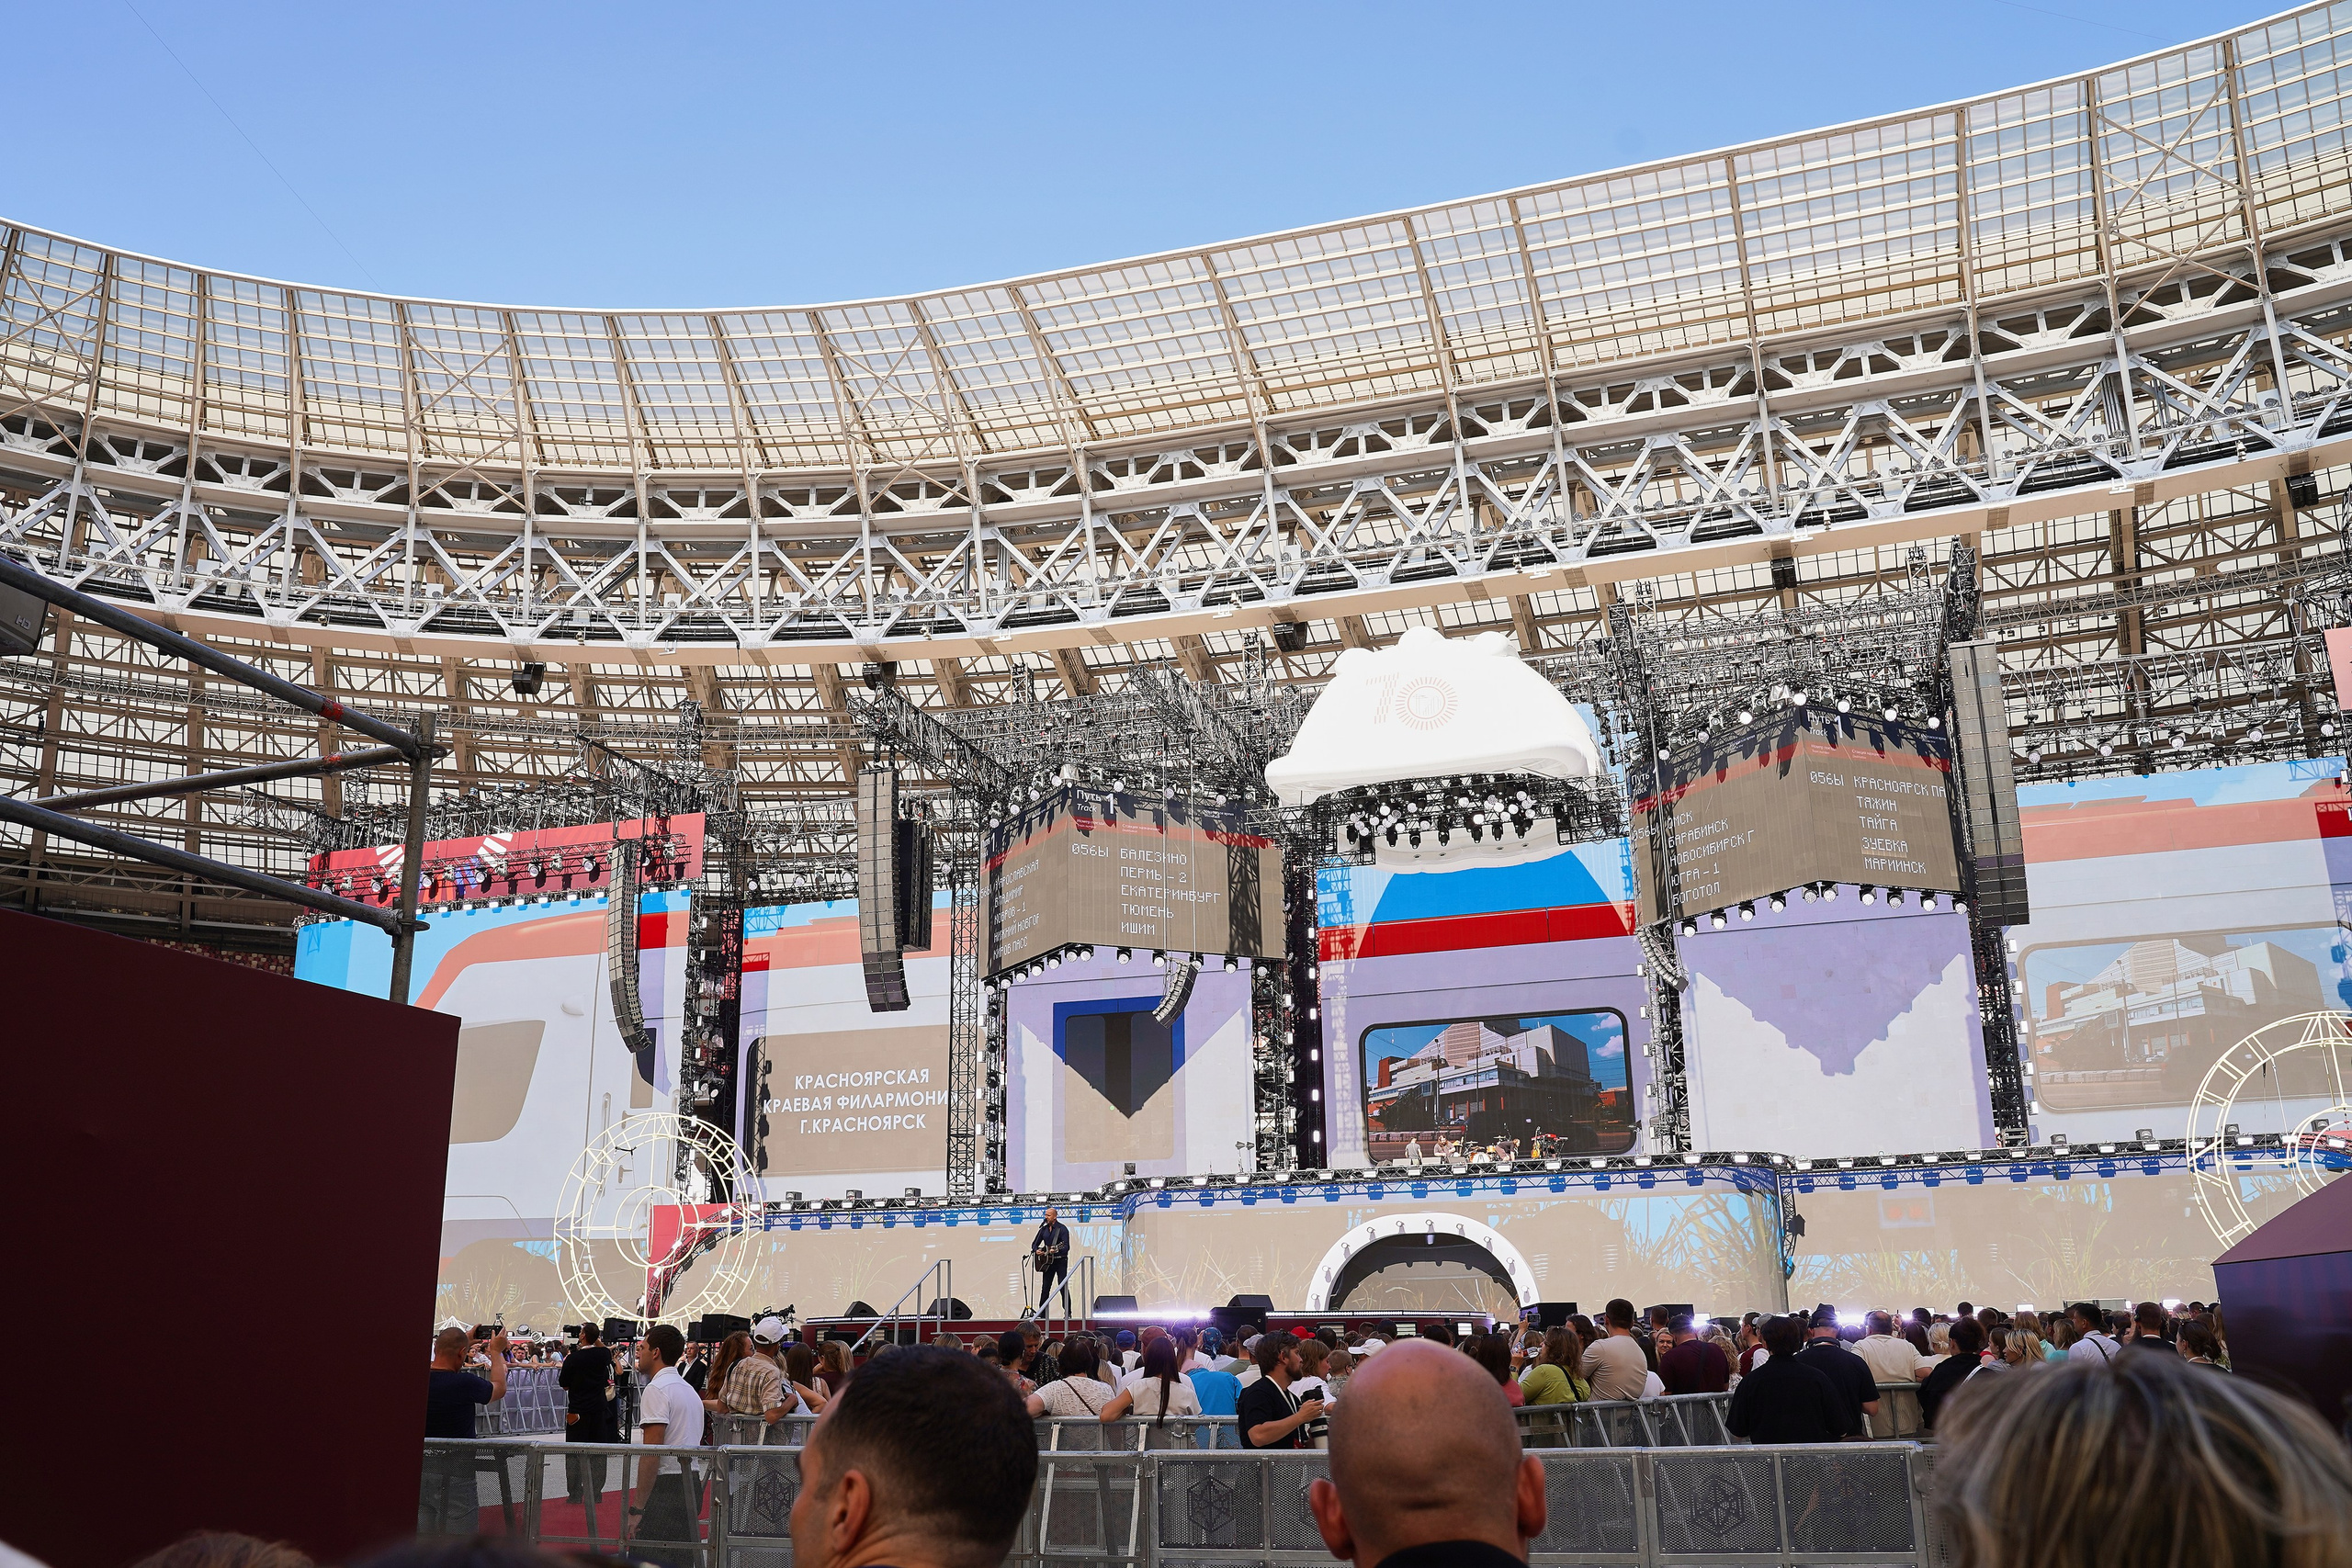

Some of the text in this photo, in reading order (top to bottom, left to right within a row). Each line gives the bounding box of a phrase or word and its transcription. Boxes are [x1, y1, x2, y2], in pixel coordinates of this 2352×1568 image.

[1853, 776, 1929, 796] КРАСНОЯРСК
[1856, 795, 1897, 812] ТАЖИН
[1859, 813, 1898, 831] ТАЙГА
[1668, 818, 1729, 849] БАРАБИНСК
[1670, 833, 1745, 866] НОВОСИБИРСК
[1861, 837, 1908, 852] ЗУЕВКА
[1120, 848, 1187, 865] БАЛЕЗИНО
[1864, 857, 1927, 874] МАРИИНСК
[1120, 866, 1162, 881] ПЕРМЬ
[1179, 872, 1187, 883] 2
[1121, 884, 1221, 904] ЕКАТЕРИНБУРГ
[1672, 882, 1720, 906] БОГОТОЛ
[1121, 903, 1174, 919] ТЮМЕНЬ
[1121, 921, 1155, 935] ИШИМ
[795, 1068, 930, 1090] КРАСНОЯРСКАЯ
[763, 1095, 831, 1114] КРАЕВАЯ
[799, 1113, 926, 1134] Г.КРАСНОЯРСК
